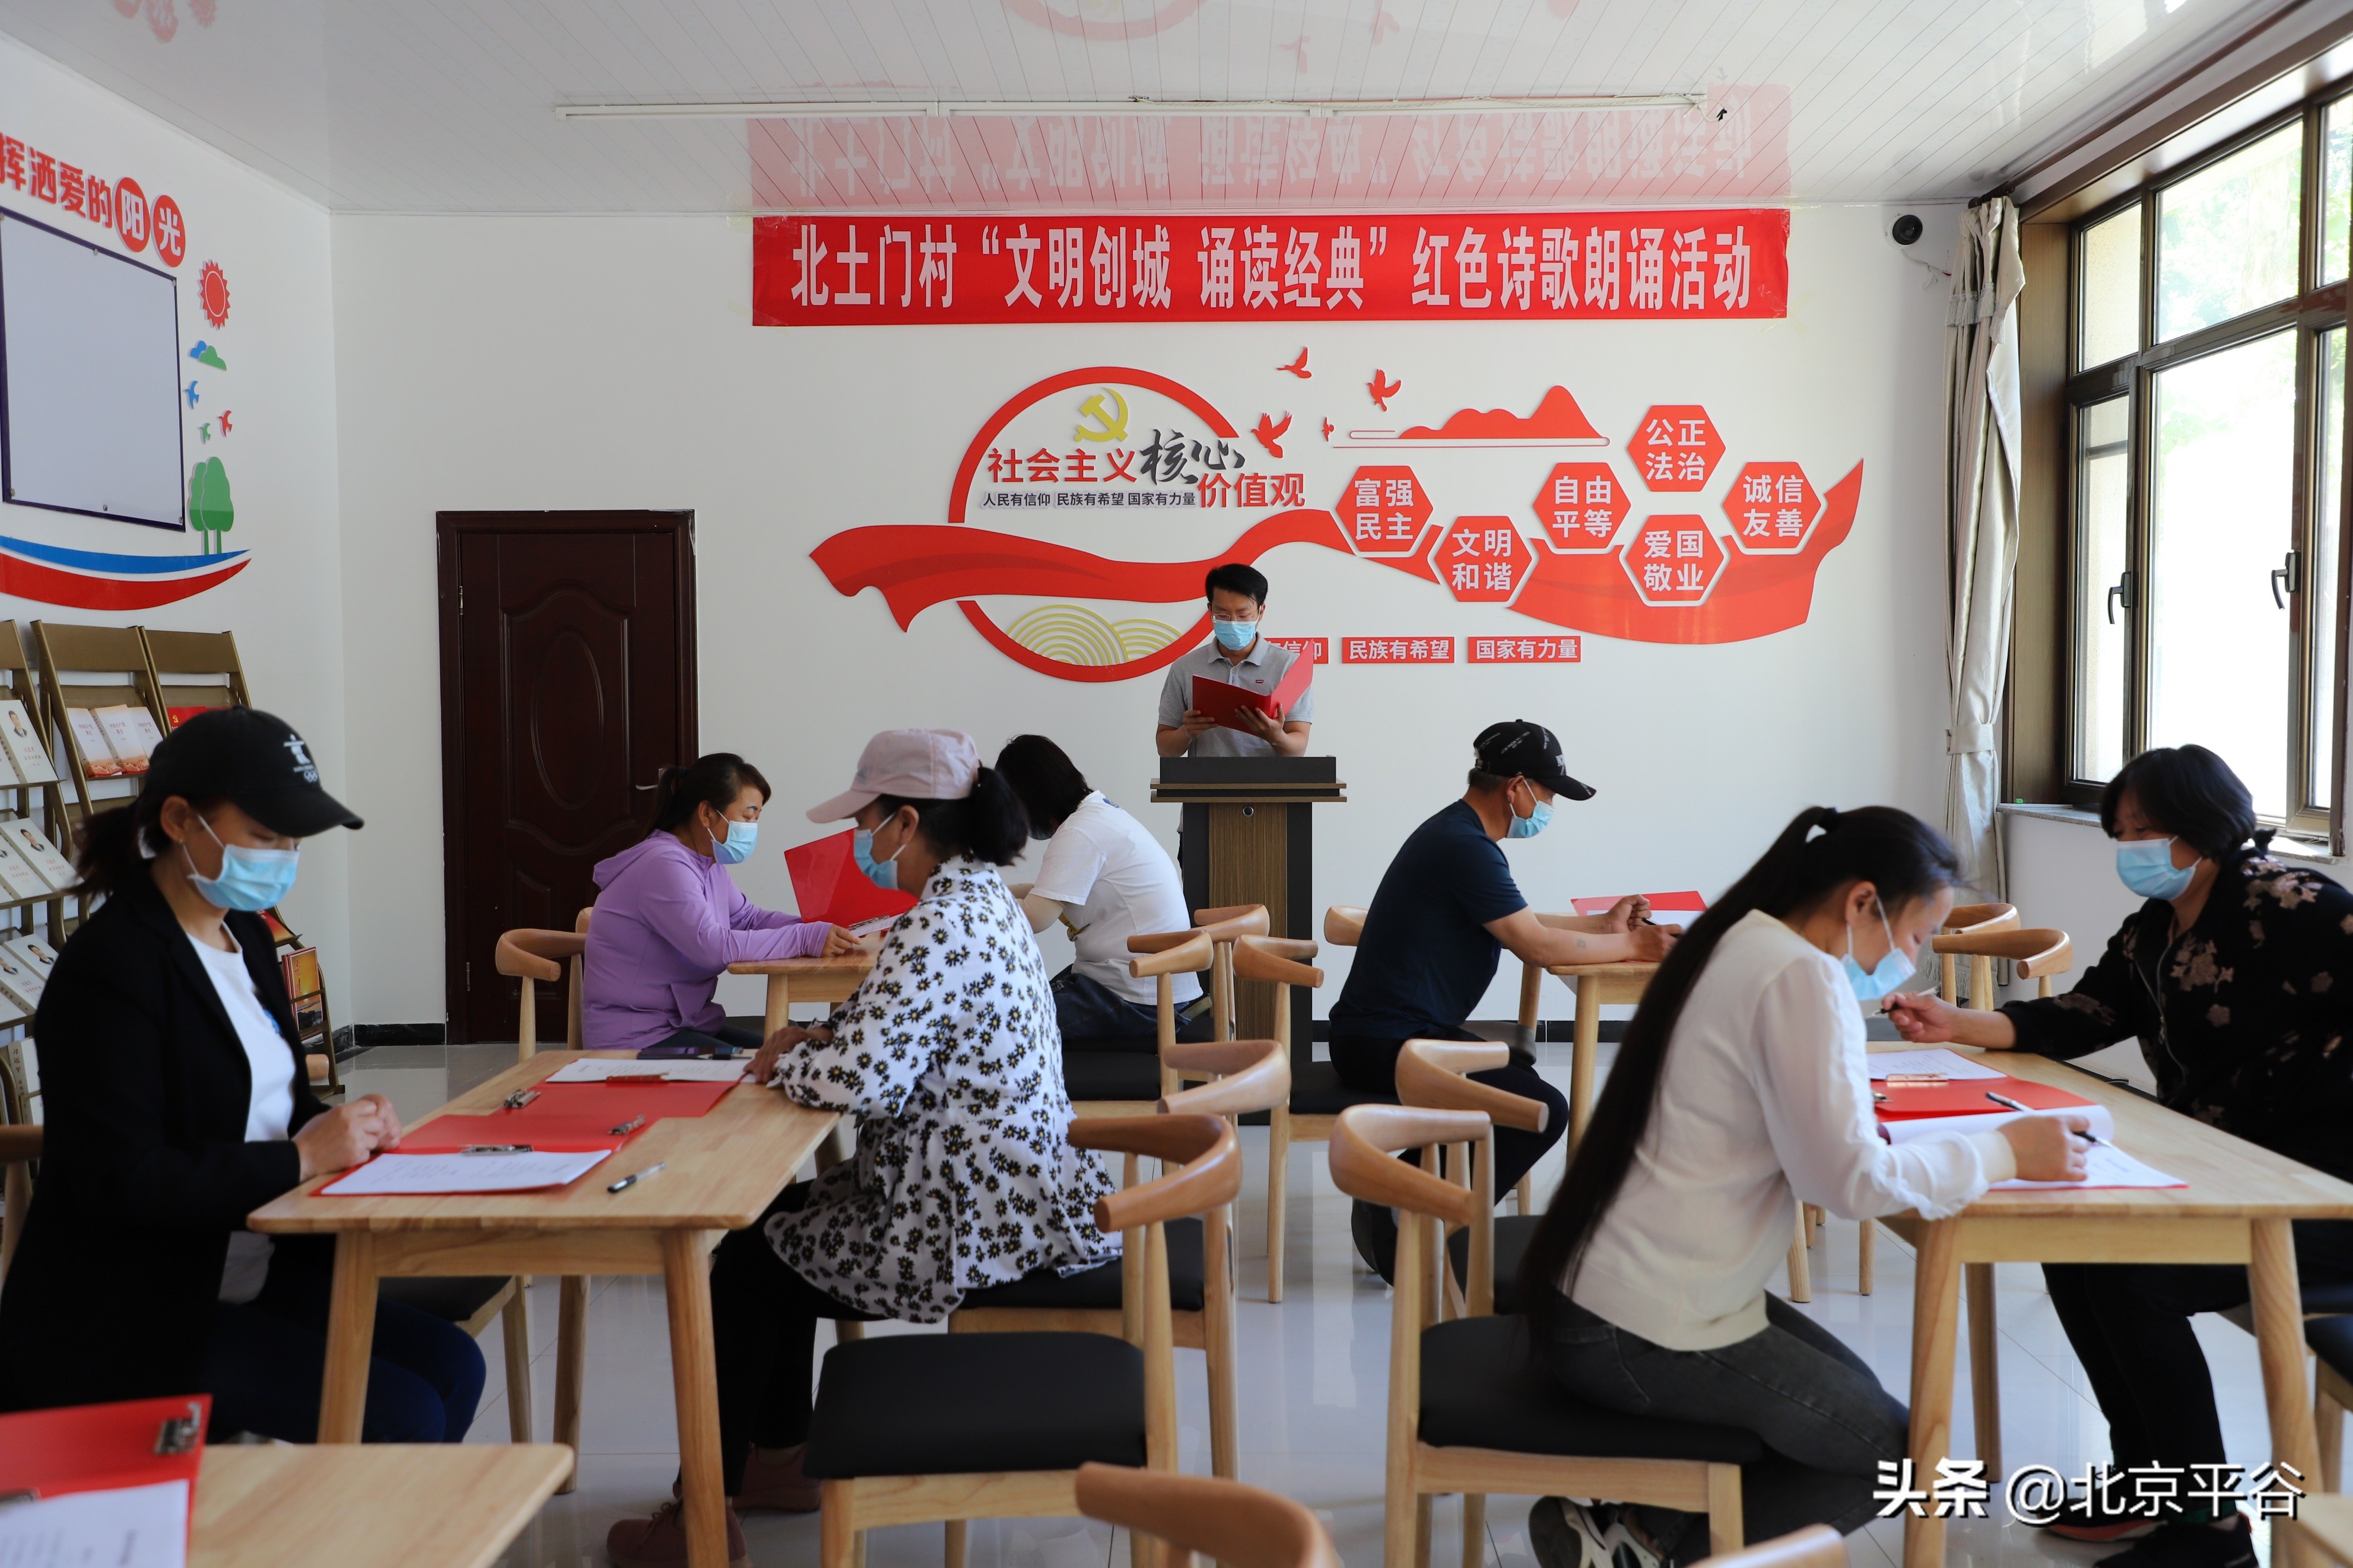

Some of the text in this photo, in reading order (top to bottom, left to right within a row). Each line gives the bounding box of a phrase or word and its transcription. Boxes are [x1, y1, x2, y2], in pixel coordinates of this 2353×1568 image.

[1646, 418, 1706, 447] 公正
[1646, 452, 1706, 482] 法治
[983, 492, 1196, 507] 人民有信仰 民族有希望 国家有力量
[1354, 478, 1414, 507] 富强
[1554, 475, 1611, 504] 自由
[1742, 475, 1802, 504] 诚信
[1355, 512, 1414, 540] 民主
[1552, 509, 1612, 538] 平等
[1742, 508, 1803, 538] 友善
[1452, 528, 1512, 557] 文明
[1643, 529, 1704, 558] 爱国
[1452, 562, 1513, 591] 和谐
[1643, 563, 1704, 592] 敬业
[1349, 640, 1449, 660] 民族有希望
[1476, 639, 1578, 660] 国家有力量
